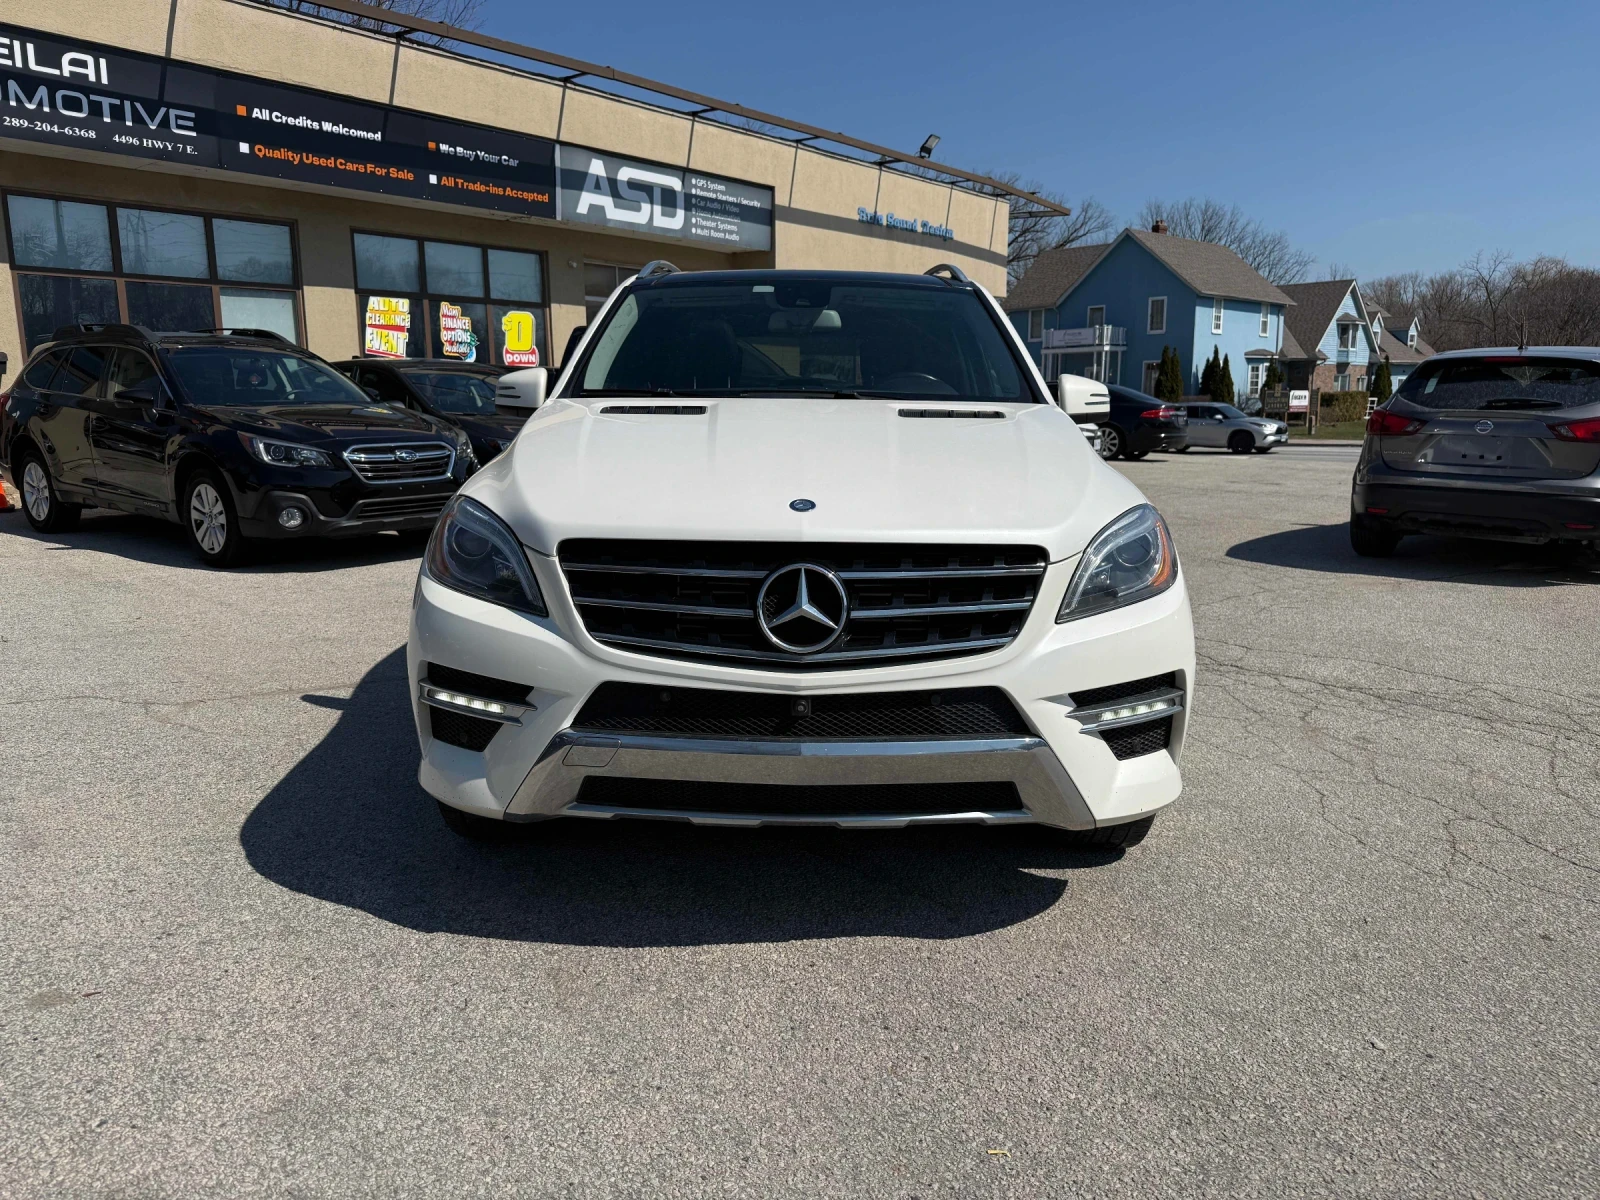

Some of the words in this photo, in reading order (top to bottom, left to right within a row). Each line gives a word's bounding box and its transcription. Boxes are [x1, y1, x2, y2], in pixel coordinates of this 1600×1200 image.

[0, 79, 197, 137] MOTIVE
[3, 116, 97, 139] 289-204-6368
[252, 107, 270, 122] All
[272, 111, 320, 131] Credits
[322, 121, 382, 142] Welcomed
[112, 133, 140, 147] 4496
[142, 138, 174, 151] HWY
[177, 144, 184, 153] 7
[186, 145, 198, 155] E.
[254, 144, 301, 165] Quality
[302, 153, 335, 168] Used
[337, 159, 366, 174] Cars
[367, 163, 387, 177] For
[389, 166, 414, 181] Sale
[439, 142, 455, 155] We
[456, 147, 476, 161] Buy
[477, 150, 500, 164] Your
[501, 155, 519, 167] Car
[440, 175, 454, 188] All
[456, 178, 504, 196] Trade-ins
[505, 186, 549, 203] Accepted
[576, 158, 685, 230] ASD
[696, 179, 707, 188] GPS
[708, 181, 726, 191] System
[696, 188, 716, 199] Remote
[717, 192, 737, 204] Starters
[741, 198, 760, 208] Security
[706, 200, 721, 210] Audio
[725, 204, 740, 213] Video
[696, 218, 717, 228] Theater
[718, 222, 738, 232] Systems
[886, 212, 918, 233] Sound
[696, 228, 710, 236] Multi
[710, 230, 724, 238] Room
[725, 232, 740, 242] Audio
[367, 296, 410, 312] AUTO
[366, 311, 411, 328] CLEARANCE
[442, 316, 470, 330] FINANCE
[366, 328, 409, 356] EVENT
[442, 330, 471, 343] OPTIONS
[505, 352, 536, 363] DOWN
